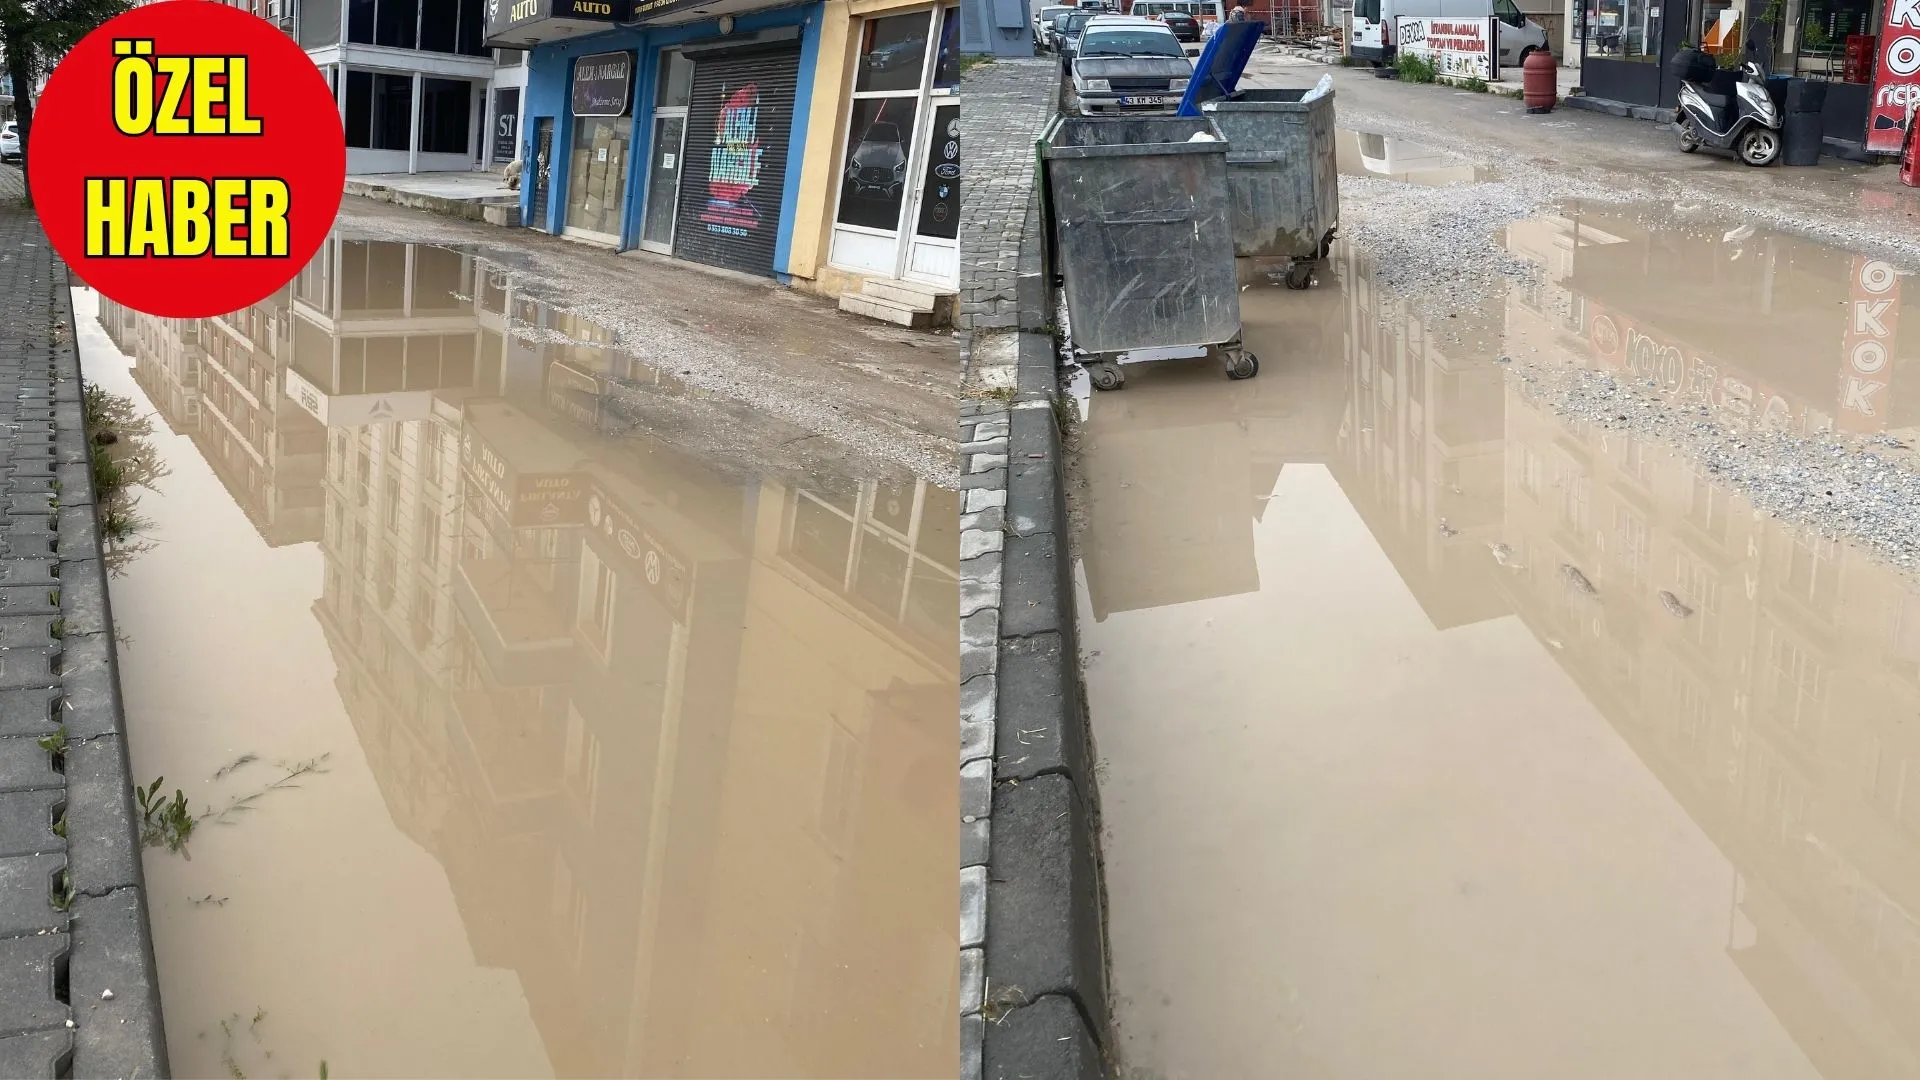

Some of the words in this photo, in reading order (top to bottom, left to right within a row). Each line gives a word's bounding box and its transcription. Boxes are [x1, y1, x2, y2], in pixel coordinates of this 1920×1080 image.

[510, 0, 538, 23] AUTO
[573, 1, 611, 15] AUTO
[1427, 37, 1447, 49] TOPTAN
[1454, 39, 1485, 52] PERAKENDE
[1149, 96, 1162, 104] 345
